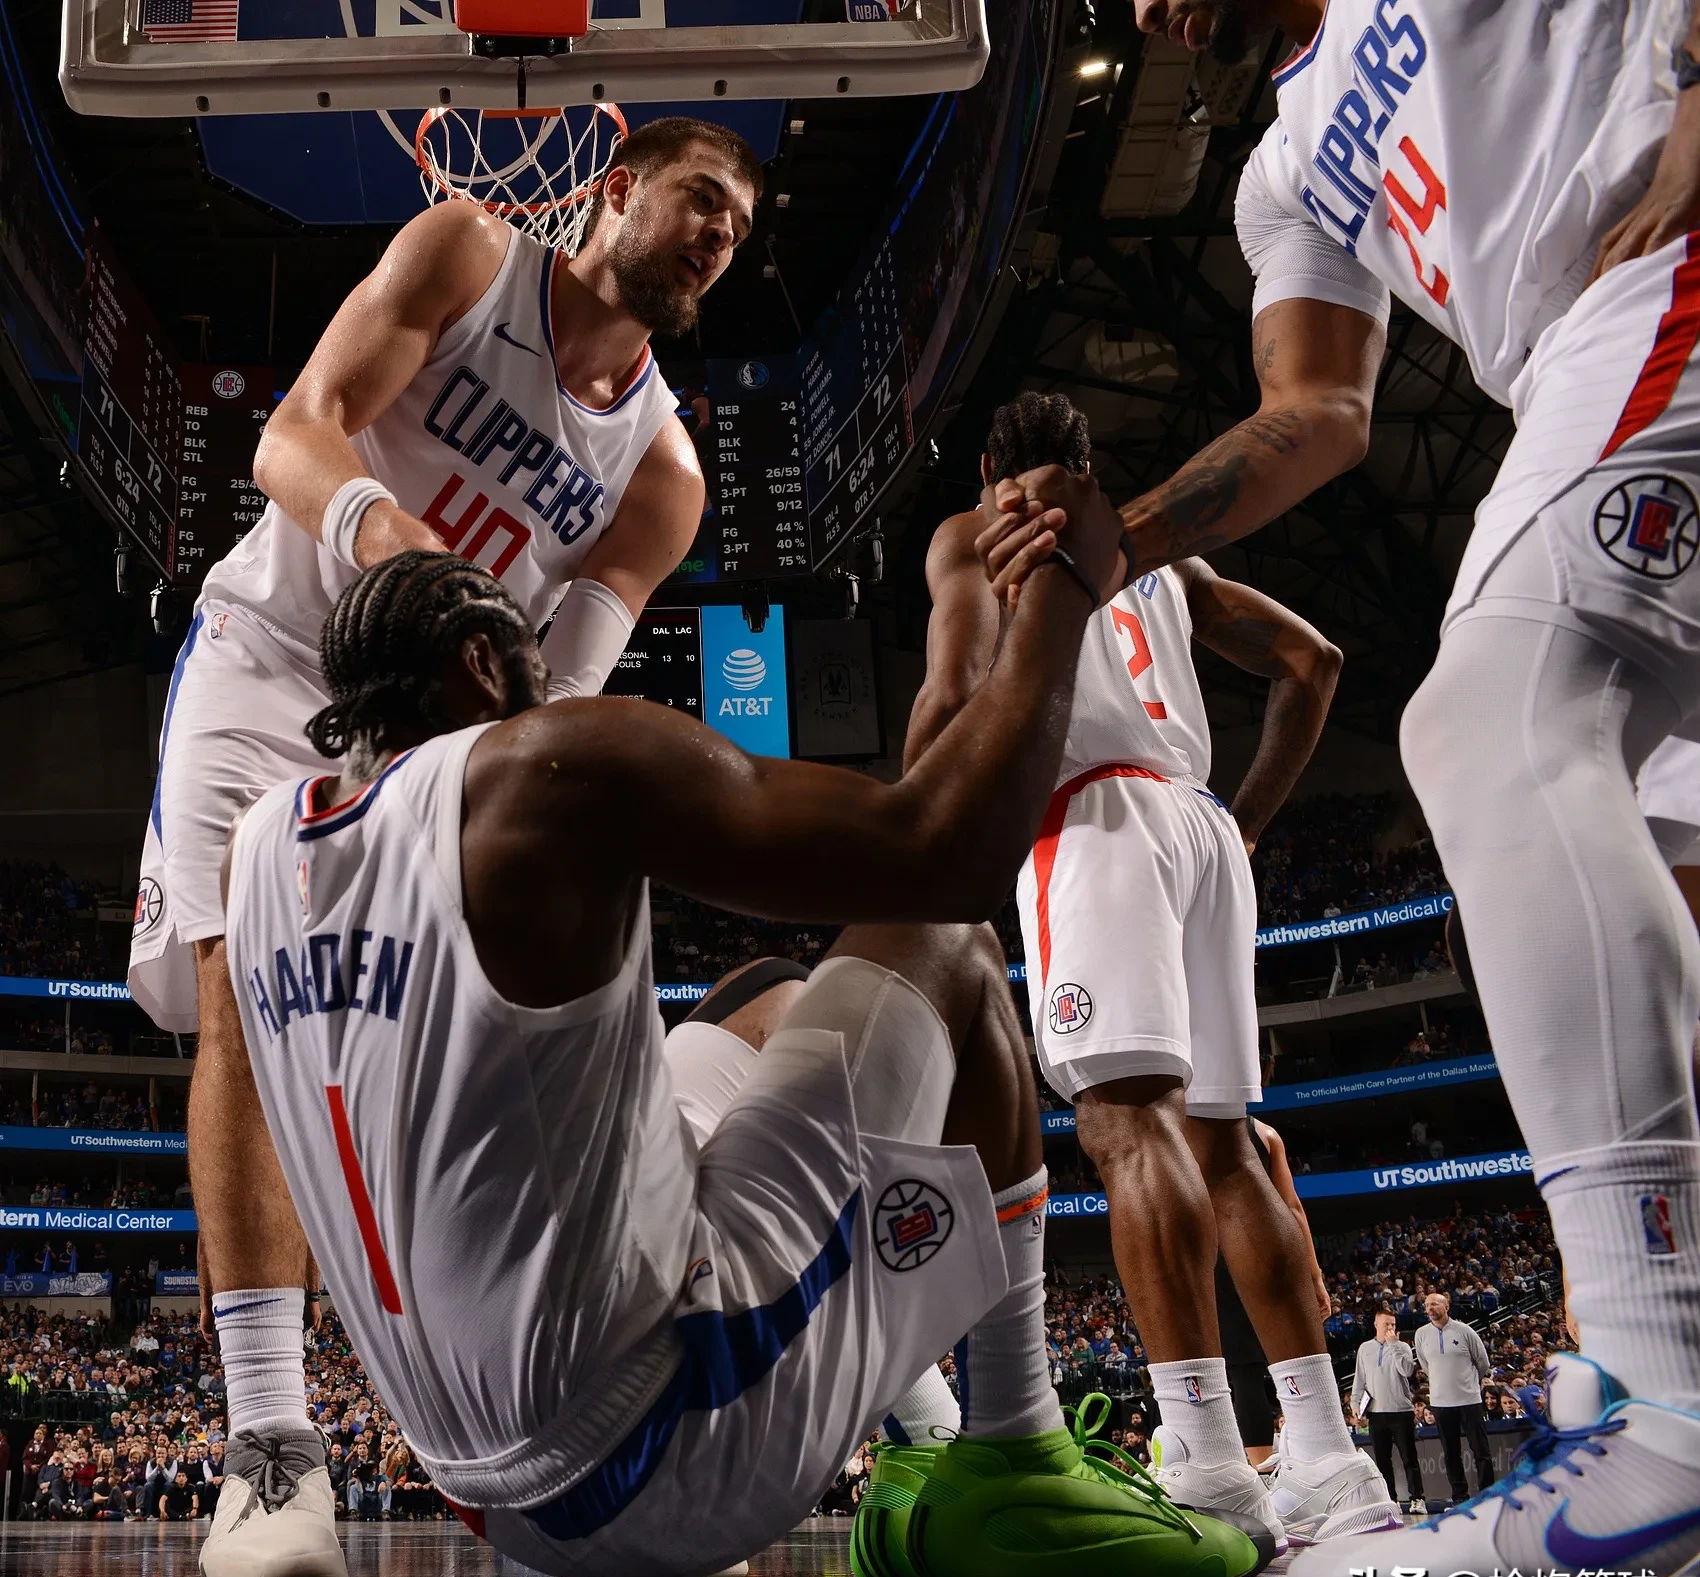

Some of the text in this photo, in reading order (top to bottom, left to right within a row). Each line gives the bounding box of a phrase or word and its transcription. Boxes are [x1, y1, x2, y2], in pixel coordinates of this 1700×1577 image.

[855, 5, 881, 20] NBA
[99, 273, 127, 327] WESTBROOK
[96, 311, 117, 351] LEONARD
[95, 329, 113, 365] POWELL
[93, 348, 110, 379] ZUBAC
[808, 360, 823, 390] HARDY
[809, 368, 832, 406] WILLIAMS
[873, 374, 891, 416] 72
[101, 385, 114, 428] 71
[186, 405, 267, 419] REB 26
[717, 401, 796, 415] REB 24
[811, 393, 829, 423] POWELL
[185, 421, 200, 431] TO
[718, 417, 797, 431] TO 4
[813, 414, 828, 441] JONES
[184, 438, 207, 448] BLK
[719, 438, 741, 448] BLK
[813, 427, 832, 458] DONCIC
[183, 452, 203, 462] STL
[424, 365, 603, 546] CLIPPERS
[719, 448, 799, 462] STL 4
[825, 444, 841, 482] 71
[147, 452, 162, 494] 72
[720, 467, 800, 482] FG 26/59
[849, 446, 874, 493] 6:24
[115, 459, 140, 504] 6:24
[182, 476, 197, 486] FG
[181, 492, 264, 505] 3-PT 8/21
[721, 483, 801, 498] 3-PT 10/25
[117, 494, 129, 519] QTR
[721, 500, 802, 515] FT 9/12
[854, 491, 868, 514] QTR
[180, 508, 263, 522] FT 14/15
[824, 512, 835, 528] TOL
[420, 472, 532, 580] 40
[722, 521, 804, 538] FG 44 %
[179, 531, 194, 541] FG
[178, 547, 204, 557] 3-PT
[723, 538, 805, 554] 3-PT 40 %
[177, 564, 191, 573] FT
[724, 555, 806, 571] FT 75 %
[1110, 603, 1168, 720] 2
[687, 698, 696, 706] 22
[719, 698, 773, 716] AT&T
[1374, 899, 1439, 928] Medical
[1296, 1090, 1310, 1100] The
[1312, 1085, 1338, 1098] Official
[1340, 1081, 1365, 1094] Health
[1366, 1078, 1385, 1089] Care
[1386, 1074, 1415, 1087] Partner
[1417, 1072, 1427, 1081] of
[1427, 1069, 1440, 1080] the
[1442, 1064, 1468, 1077] Dallas
[333, 1085, 403, 1315] 1
[45, 1212, 113, 1229] Medical
[116, 1213, 173, 1229] Center
[4, 1280, 33, 1292] EVO
